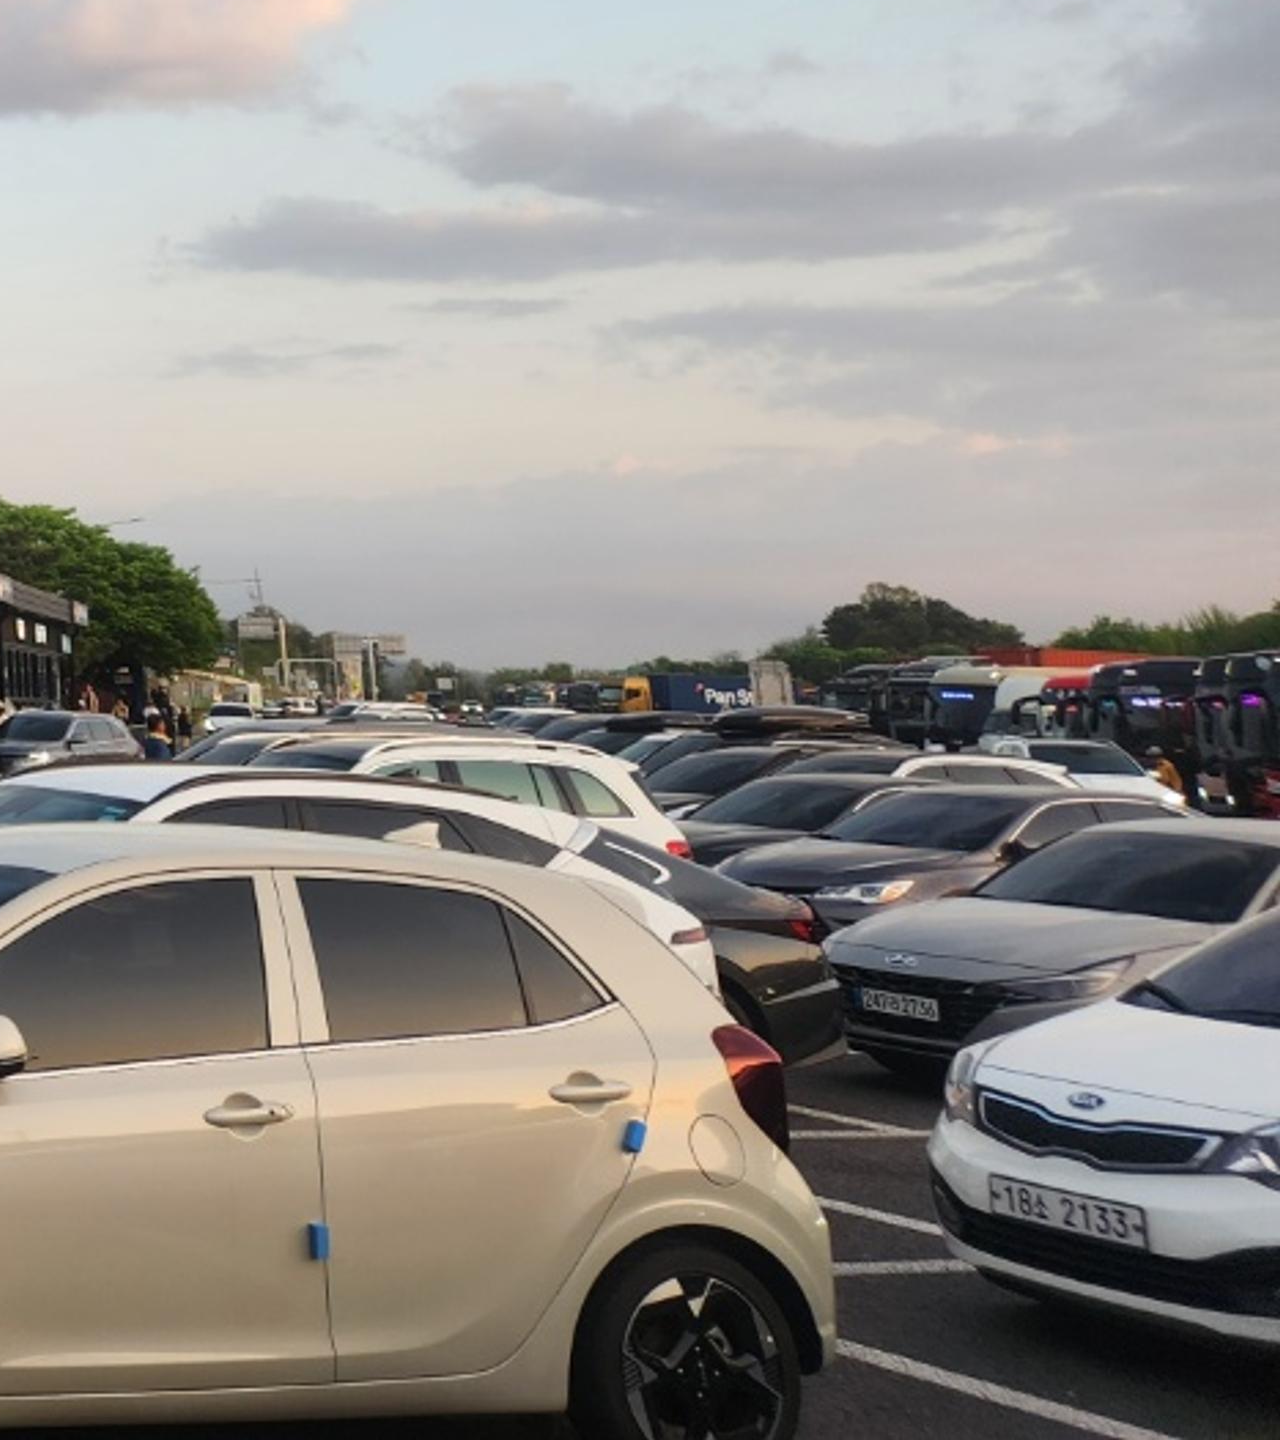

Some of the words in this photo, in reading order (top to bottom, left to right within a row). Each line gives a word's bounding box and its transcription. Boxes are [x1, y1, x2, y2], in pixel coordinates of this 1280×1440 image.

[704, 688, 736, 705] Pan
[1003, 1184, 1050, 1221] 18소
[1059, 1196, 1130, 1239] 2133
